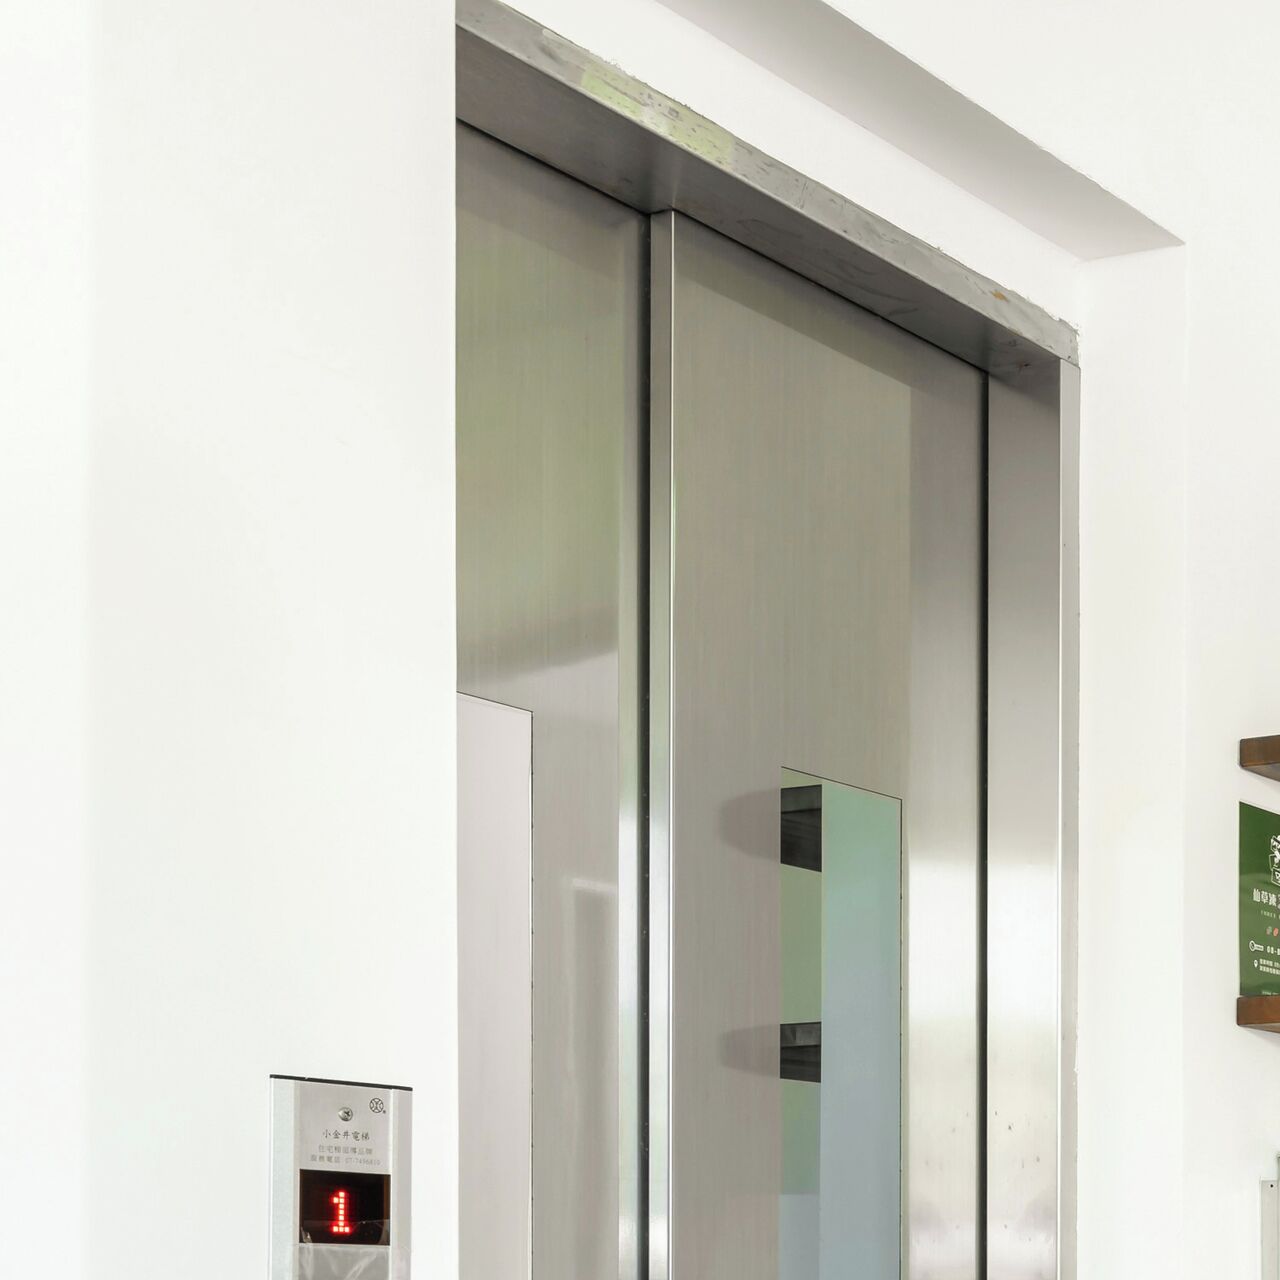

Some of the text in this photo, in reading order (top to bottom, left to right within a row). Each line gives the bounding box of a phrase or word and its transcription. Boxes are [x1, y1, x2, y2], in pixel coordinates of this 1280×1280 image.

[322, 1129, 370, 1142] 小金井電梯
[332, 1191, 350, 1232] 1
